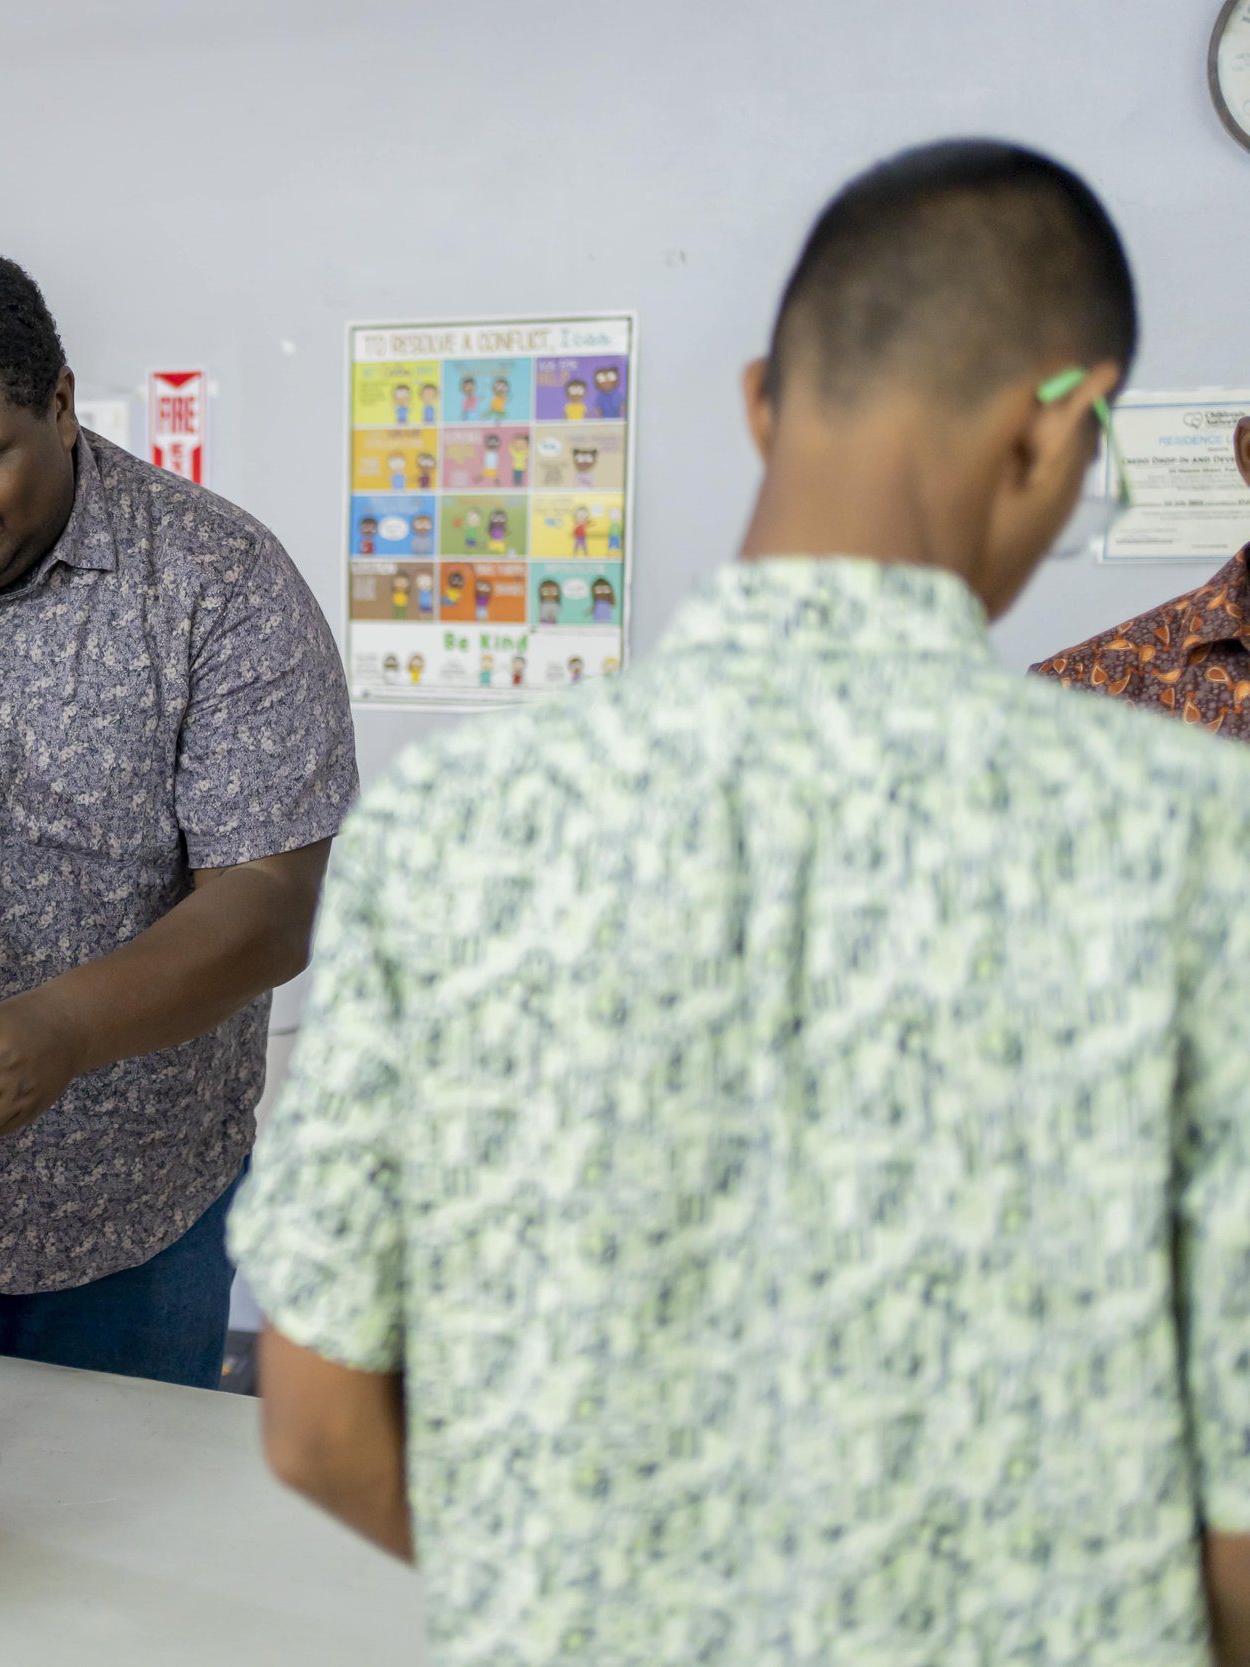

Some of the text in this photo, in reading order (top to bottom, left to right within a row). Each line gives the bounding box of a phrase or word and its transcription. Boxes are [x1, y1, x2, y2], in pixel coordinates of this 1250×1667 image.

[390, 331, 459, 354] RESOLVE
[461, 331, 472, 350] A
[1158, 435, 1223, 446] RESIDENCE
[443, 631, 529, 653] Be Kind
